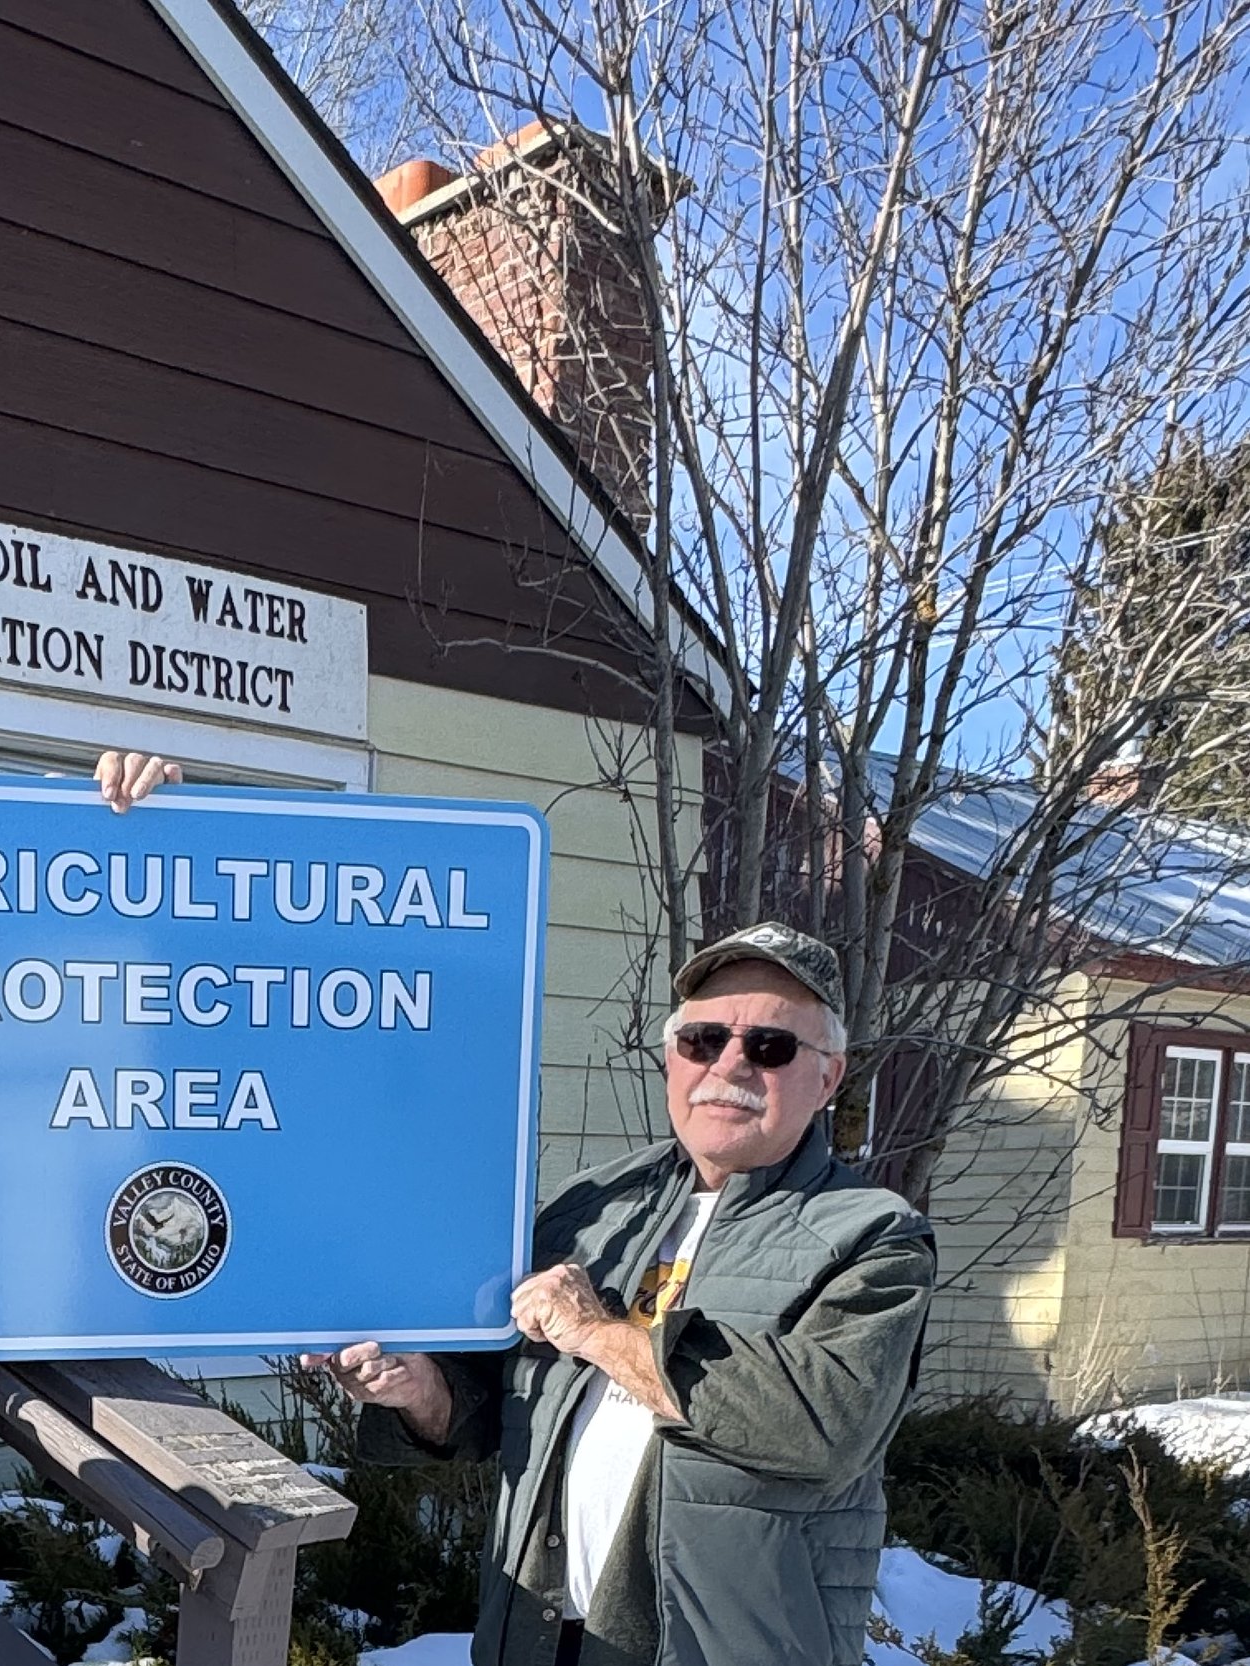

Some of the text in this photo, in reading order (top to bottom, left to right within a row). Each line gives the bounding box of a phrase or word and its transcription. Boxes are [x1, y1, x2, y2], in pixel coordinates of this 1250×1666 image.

[75, 556, 163, 613] AND
[185, 575, 308, 644] WATER
[128, 640, 294, 713] DISTRICT
[50, 1069, 280, 1131] AREA
[113, 1171, 224, 1227] VALLEY COUNTY
[116, 1244, 220, 1290] STATE OF IDAHO
